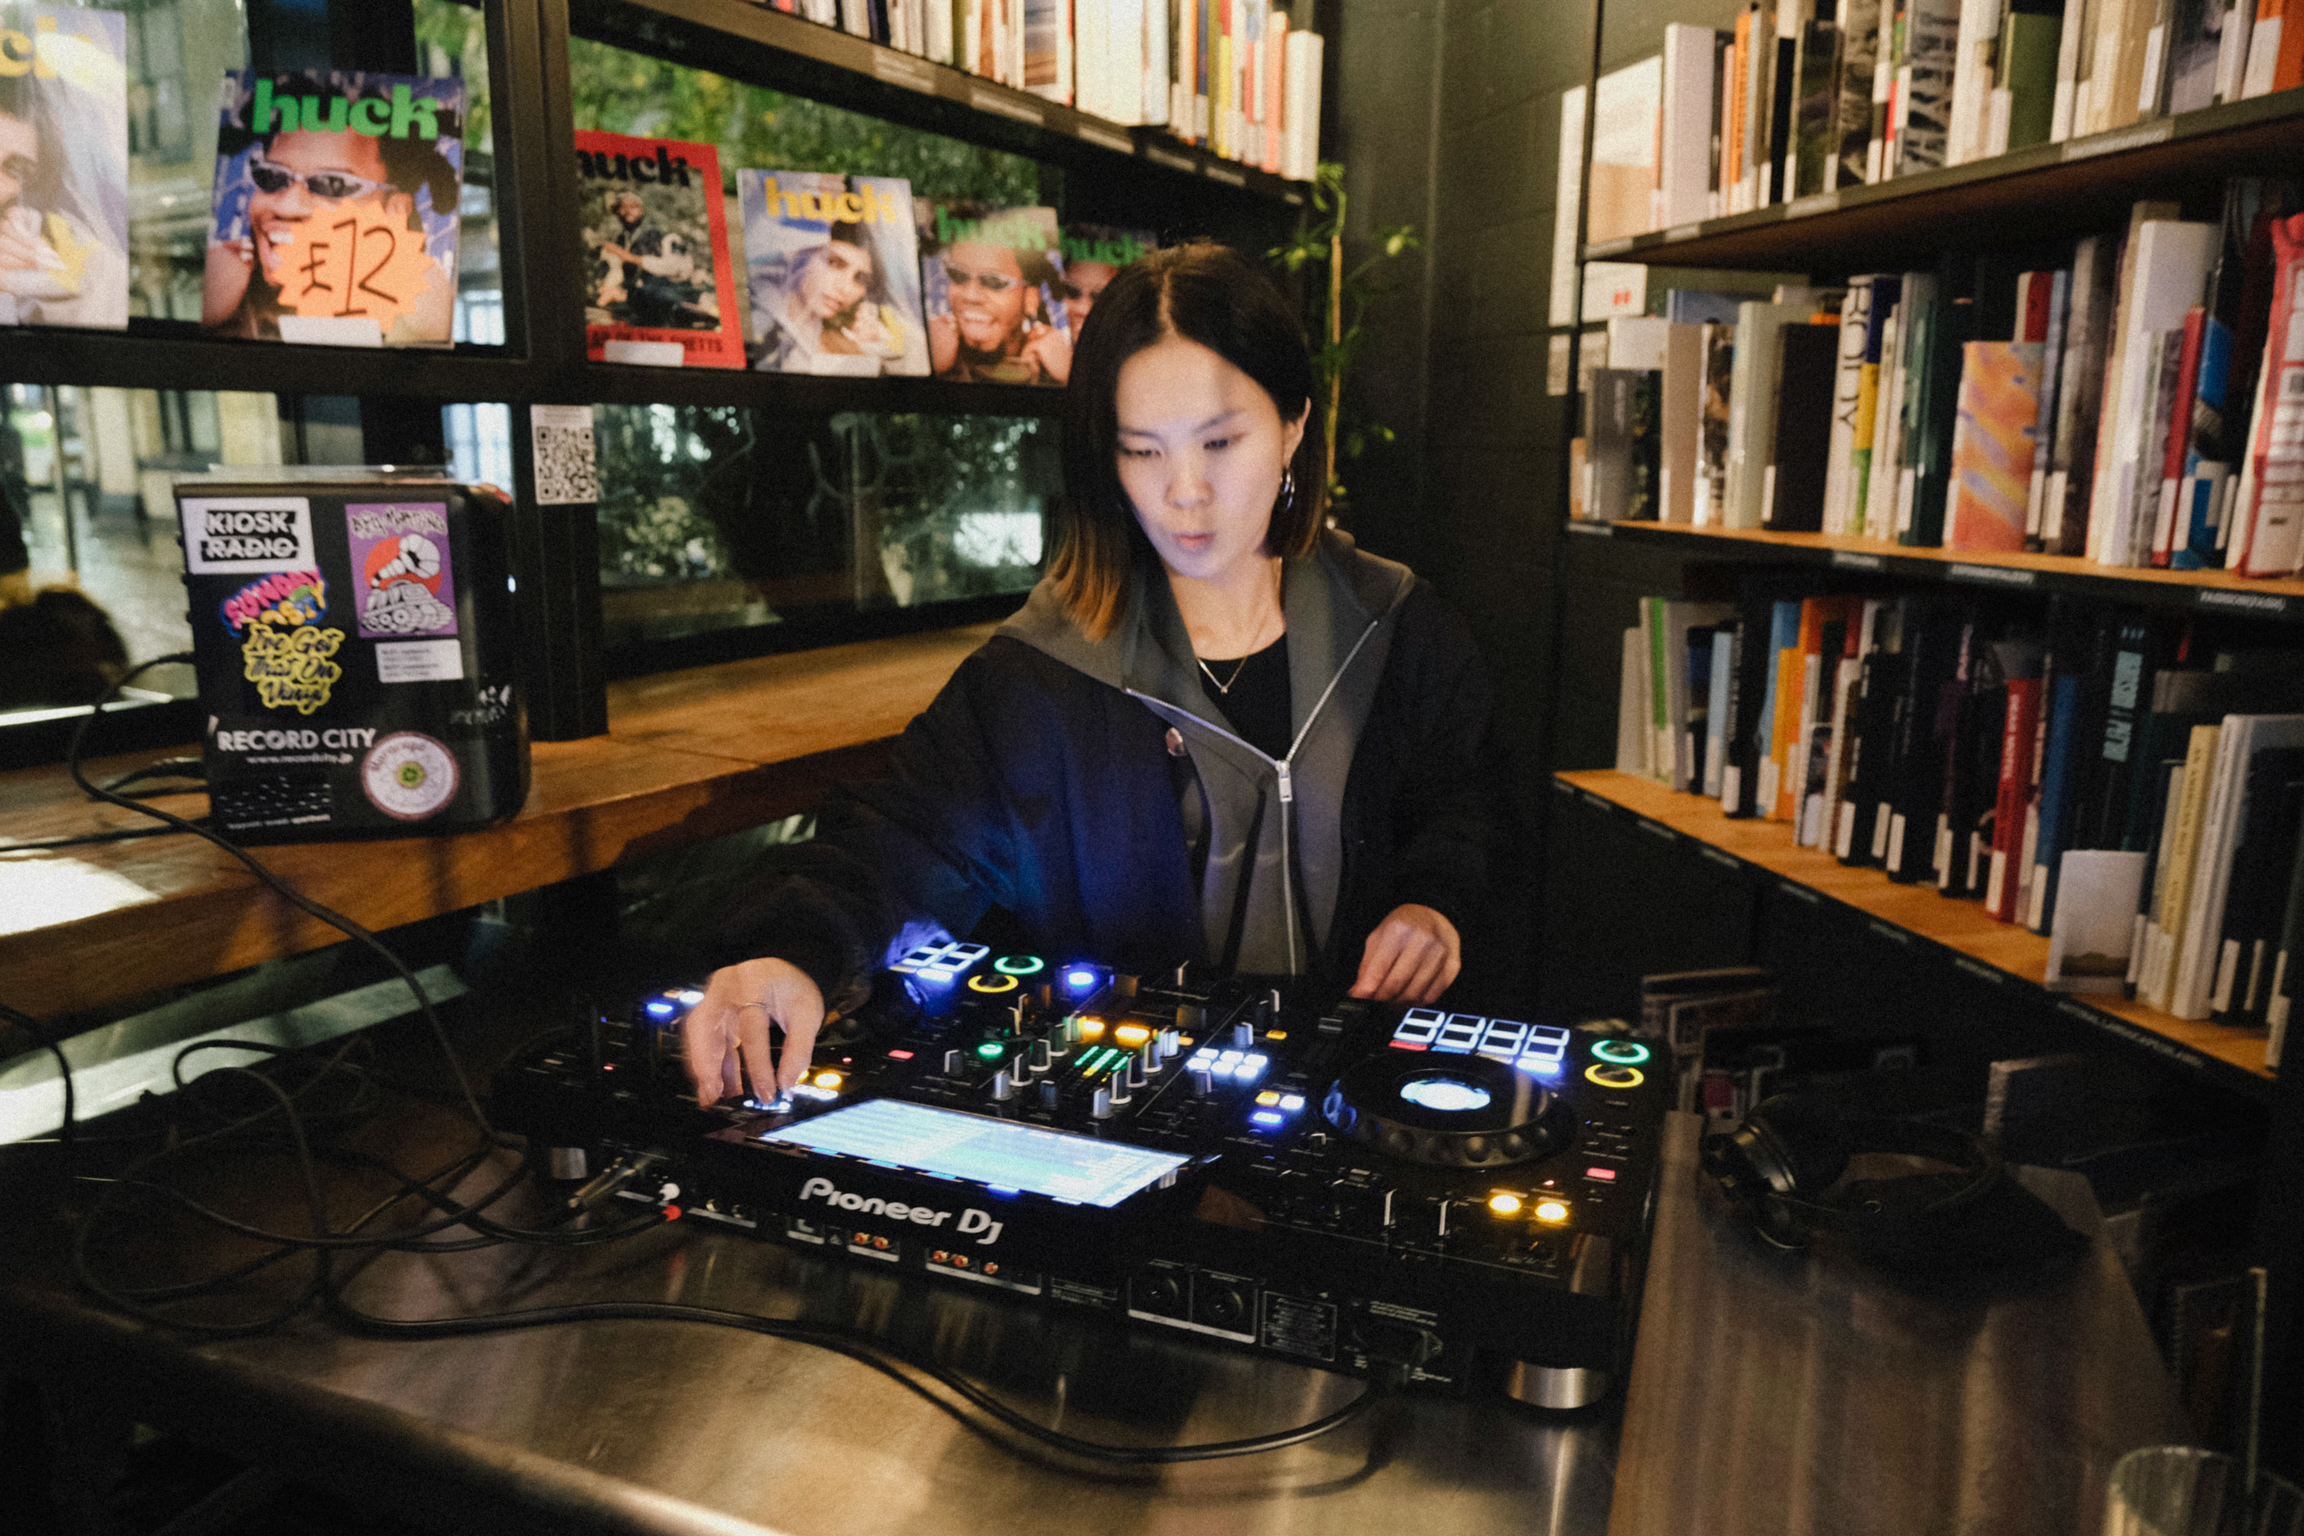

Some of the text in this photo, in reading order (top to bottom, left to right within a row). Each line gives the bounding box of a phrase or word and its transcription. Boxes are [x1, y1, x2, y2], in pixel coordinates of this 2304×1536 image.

[252, 78, 439, 140] huck
[764, 176, 897, 224] huck
[300, 217, 400, 316] £12
[205, 511, 290, 535] KIOSK
[205, 536, 296, 559] RADIO
[217, 727, 377, 751] RECORD CITY
[799, 1176, 953, 1228] Pioneer
